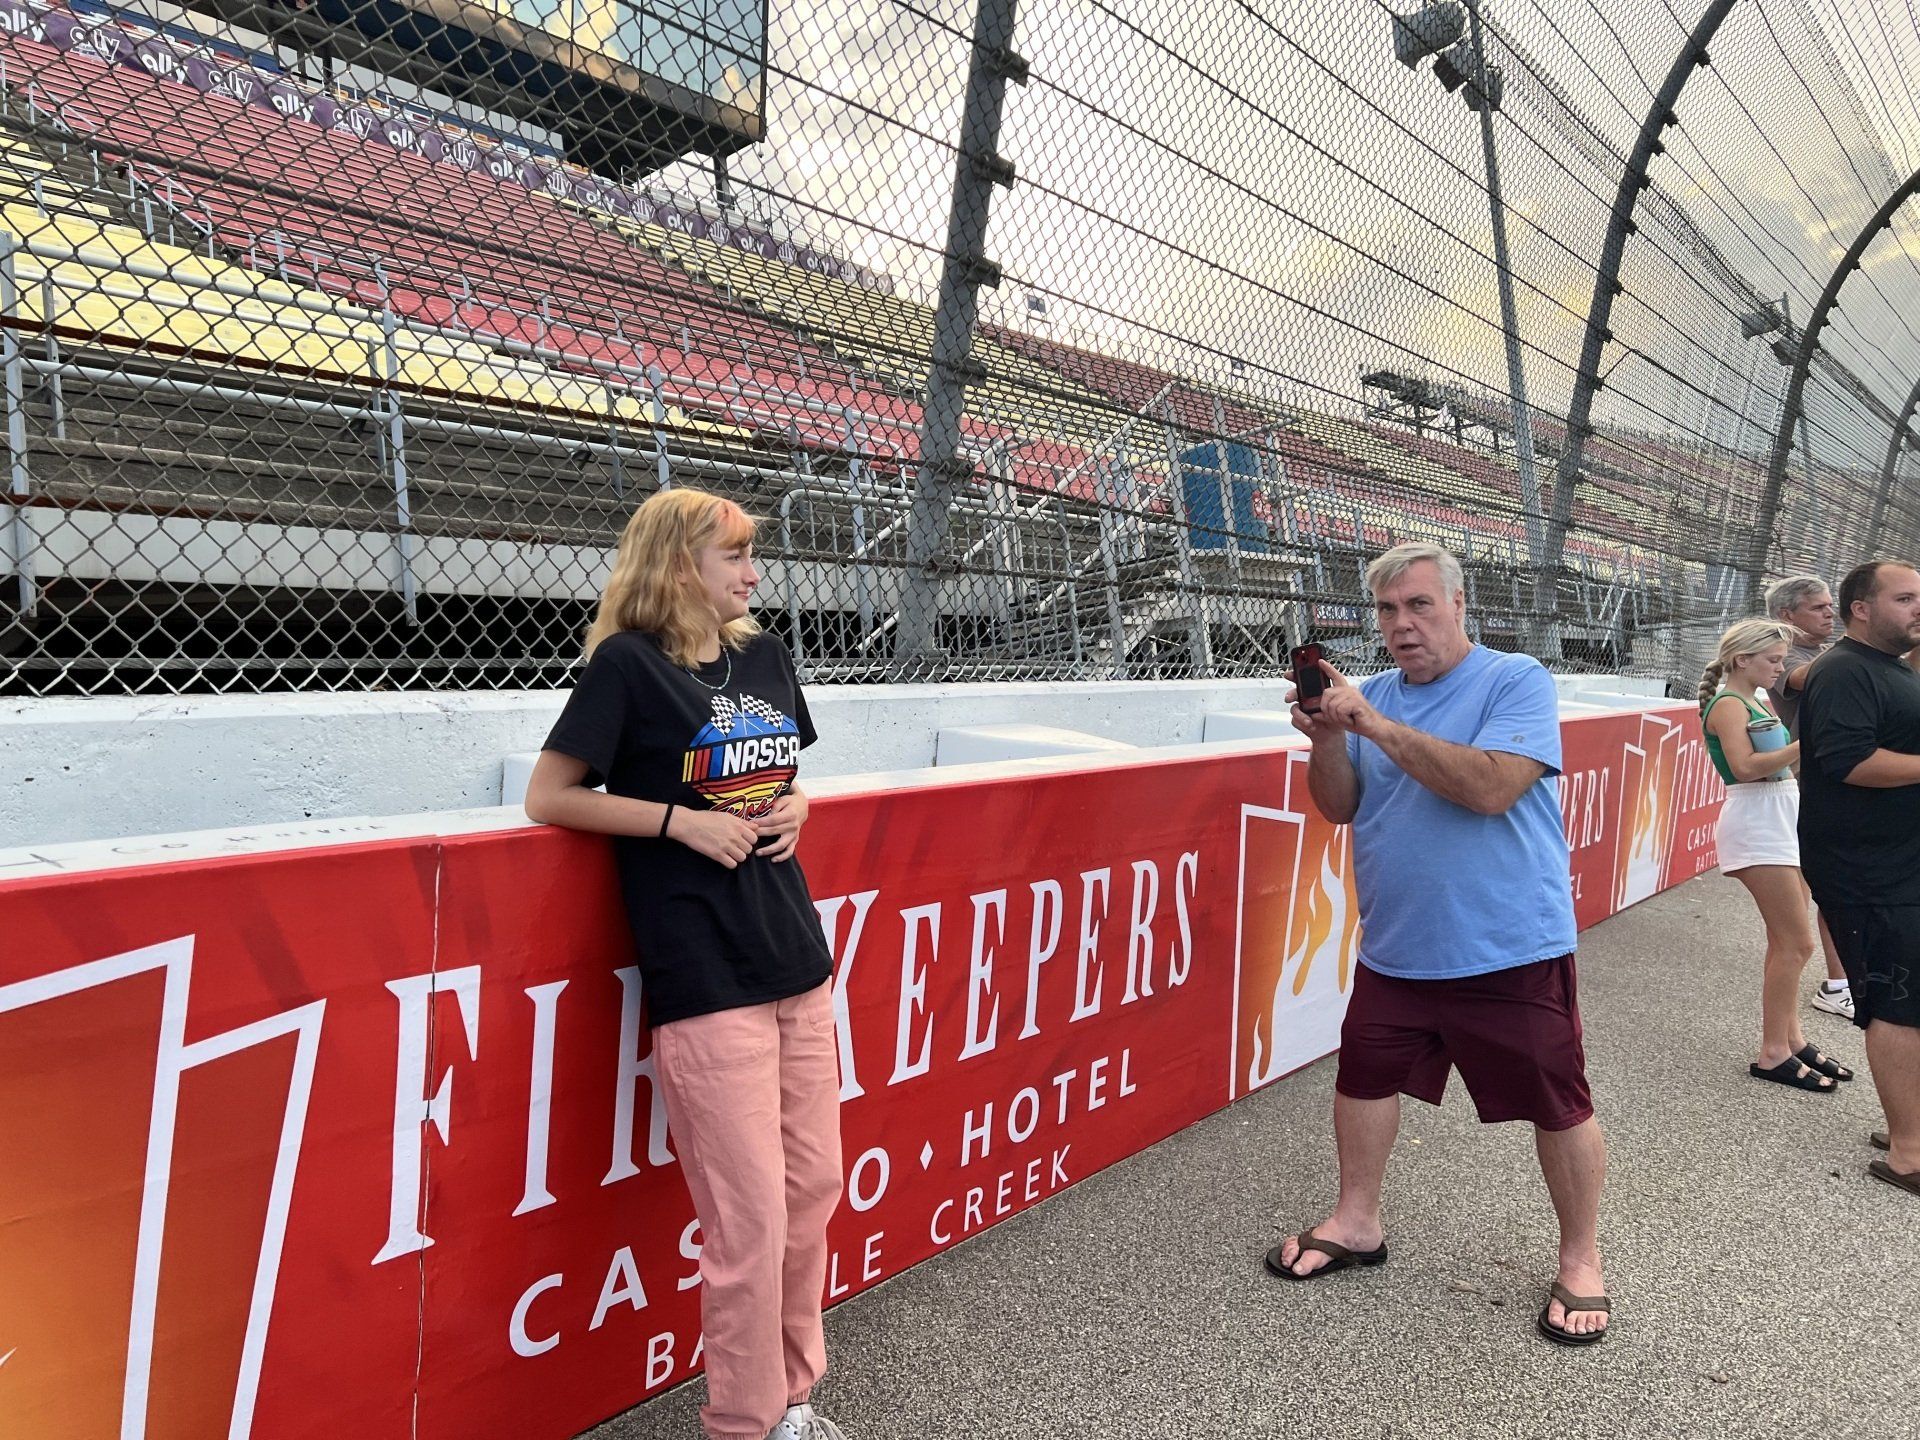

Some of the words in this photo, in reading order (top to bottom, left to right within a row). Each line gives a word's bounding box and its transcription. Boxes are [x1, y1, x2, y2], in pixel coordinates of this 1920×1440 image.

[142, 52, 188, 84] ally
[272, 93, 315, 123] ally
[722, 736, 800, 777] NASCA
[1687, 822, 1717, 851] CASIN
[1695, 851, 1719, 873] BATTL
[371, 850, 1199, 1266] FIRKEEPERS
[509, 1146, 891, 1358] CASO
[960, 1049, 1137, 1167] HOTEL
[930, 1144, 1072, 1245] CREEK
